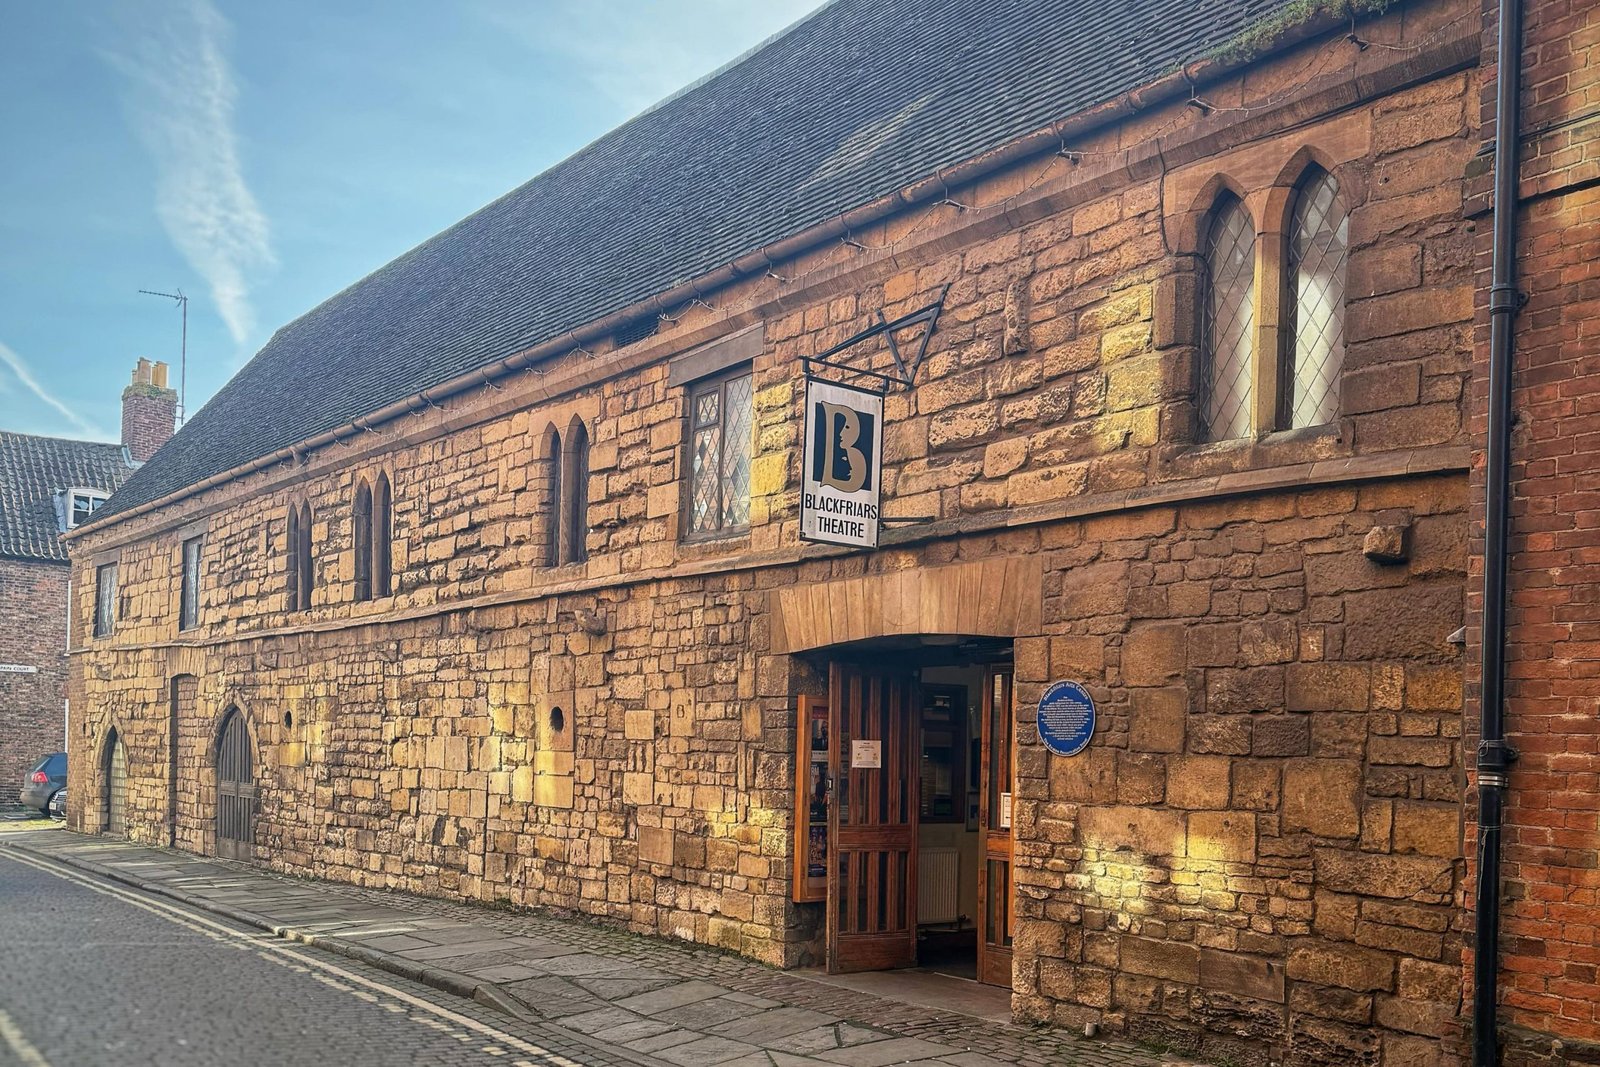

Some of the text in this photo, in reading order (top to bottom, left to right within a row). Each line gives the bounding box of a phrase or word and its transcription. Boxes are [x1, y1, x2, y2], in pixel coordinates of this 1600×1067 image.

[820, 400, 867, 493] B
[805, 493, 877, 520] BLACKFRIARS
[817, 515, 865, 538] THEATRE
[1043, 683, 1065, 701] Blackfriars
[1075, 685, 1089, 700] Centre
